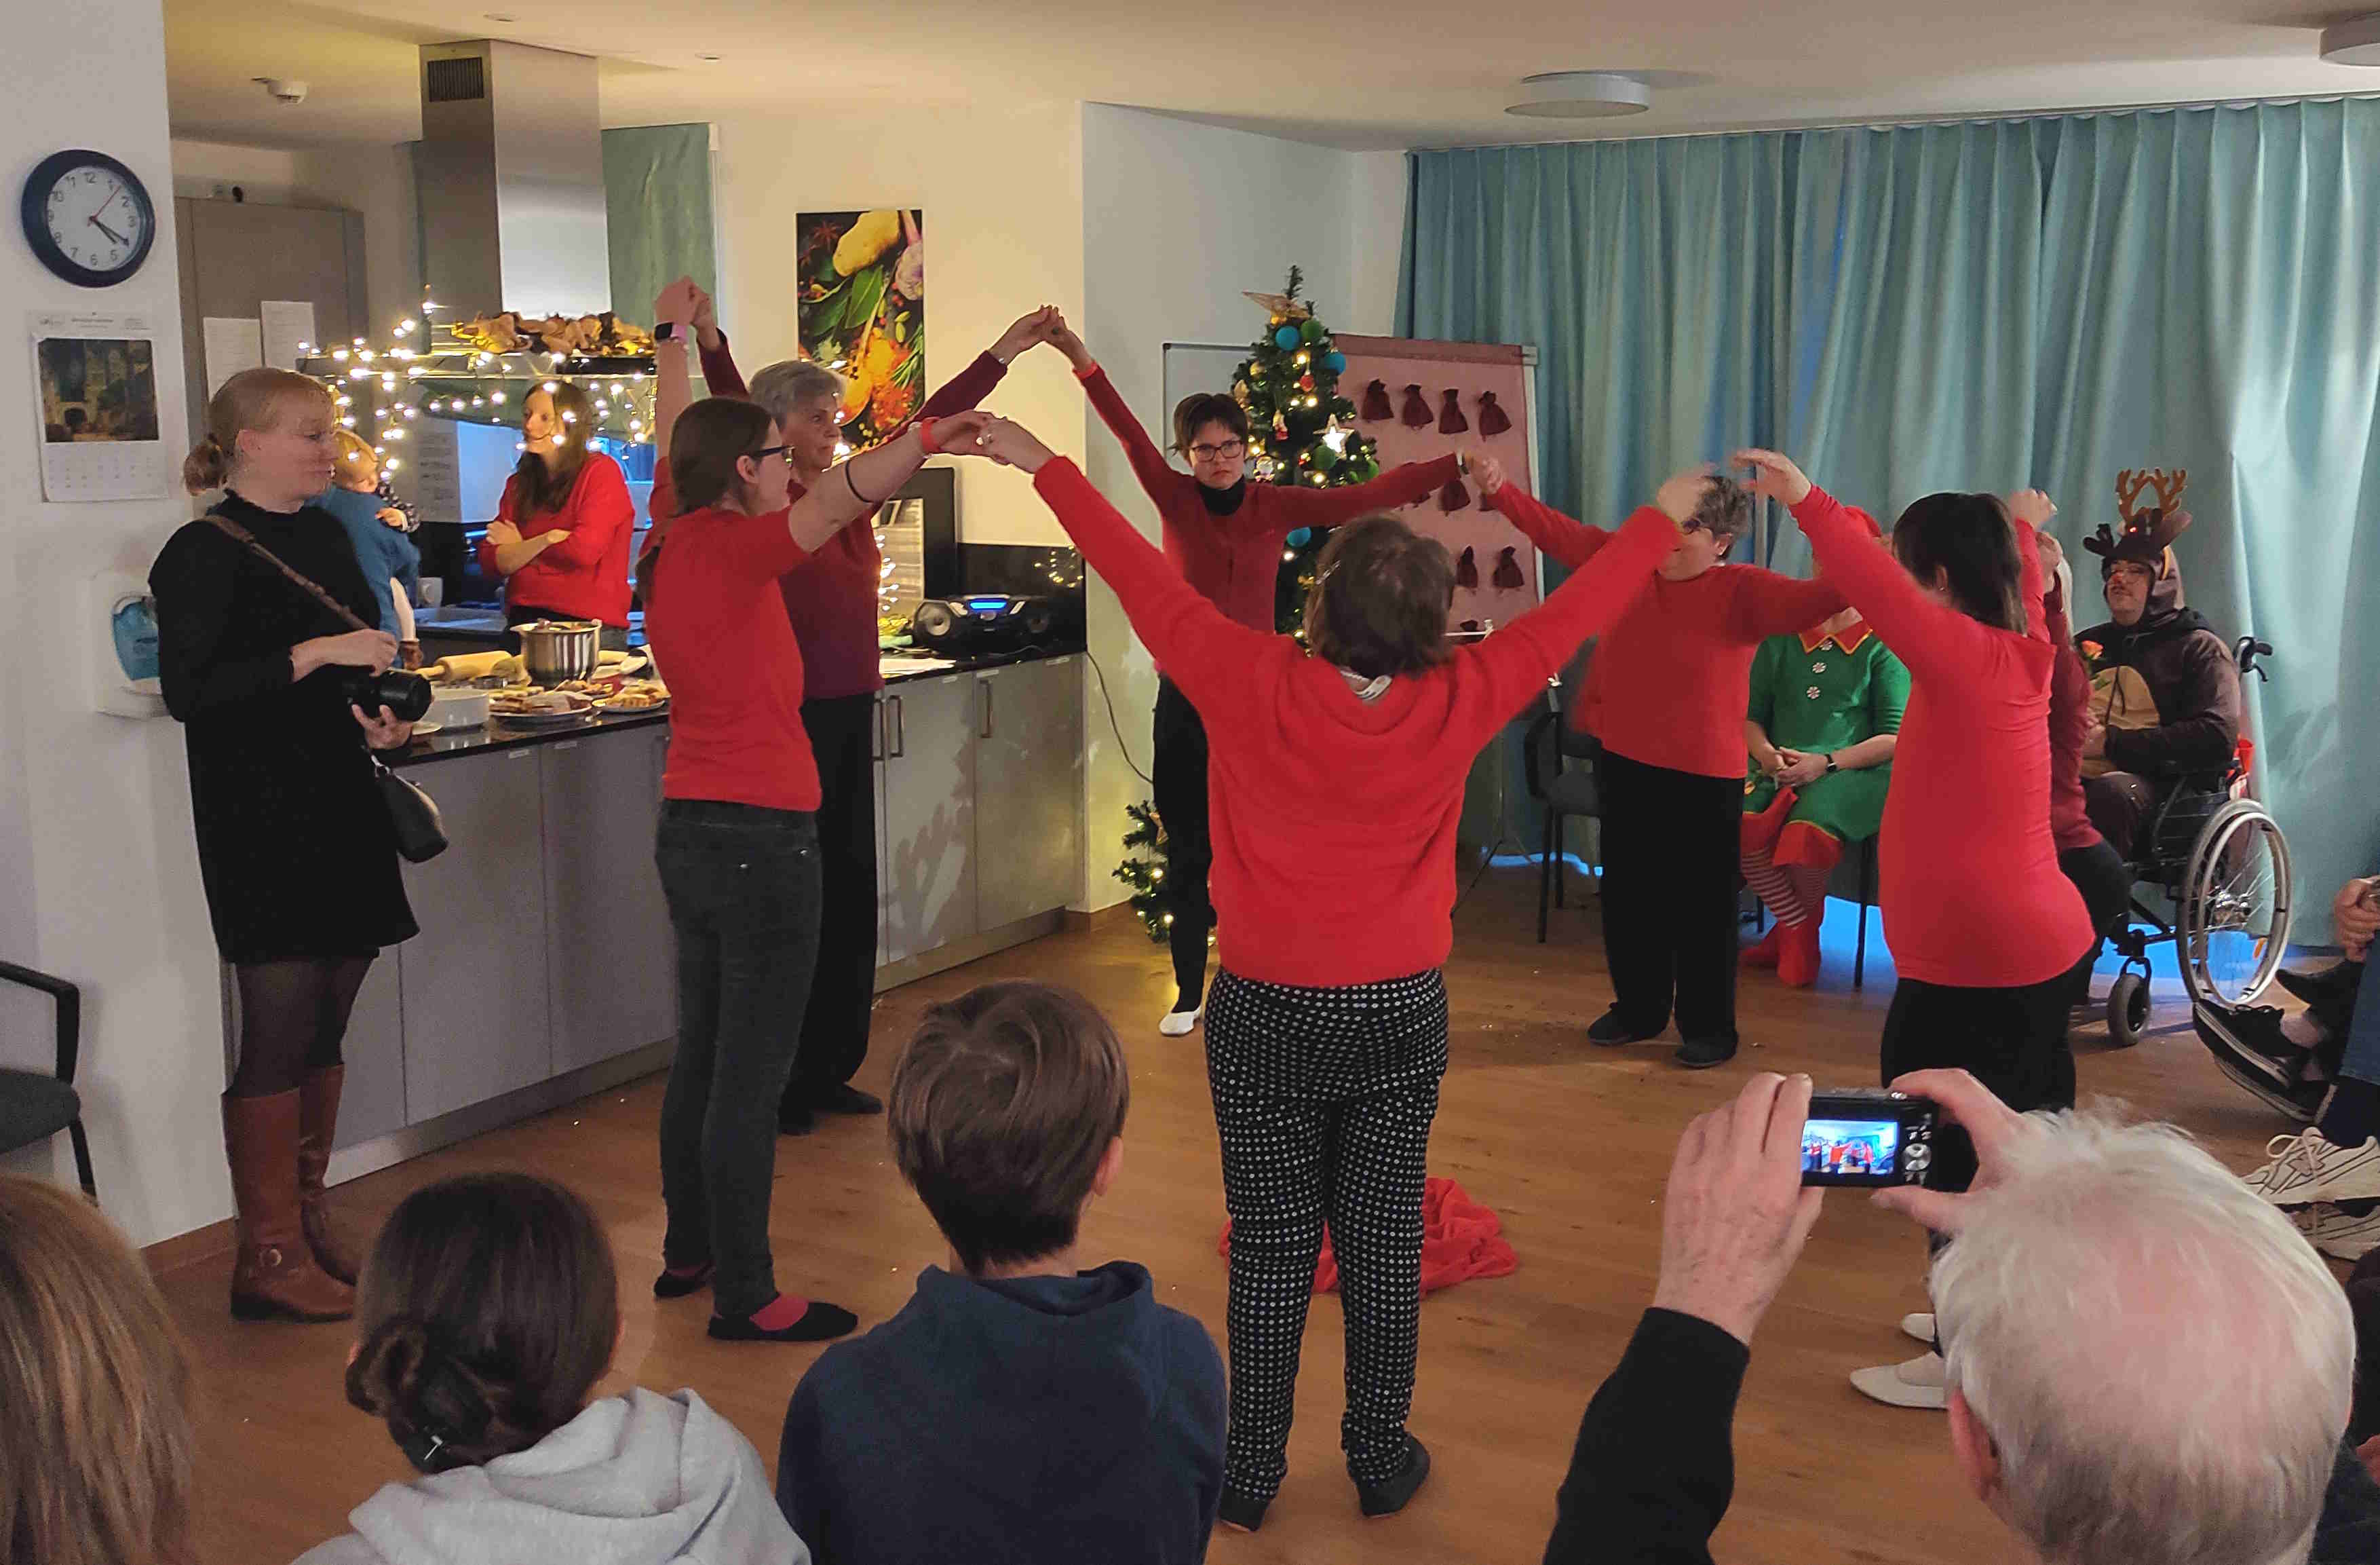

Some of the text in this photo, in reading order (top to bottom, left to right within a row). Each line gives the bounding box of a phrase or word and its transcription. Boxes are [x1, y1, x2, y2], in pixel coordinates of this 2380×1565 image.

[66, 175, 77, 188] 11
[83, 172, 97, 184] 12
[51, 190, 64, 203] 10
[120, 195, 130, 208] 2
[128, 215, 137, 228] 3
[54, 232, 62, 244] 8
[71, 247, 79, 259] 7
[109, 250, 119, 261] 5
[90, 254, 98, 266] 6
